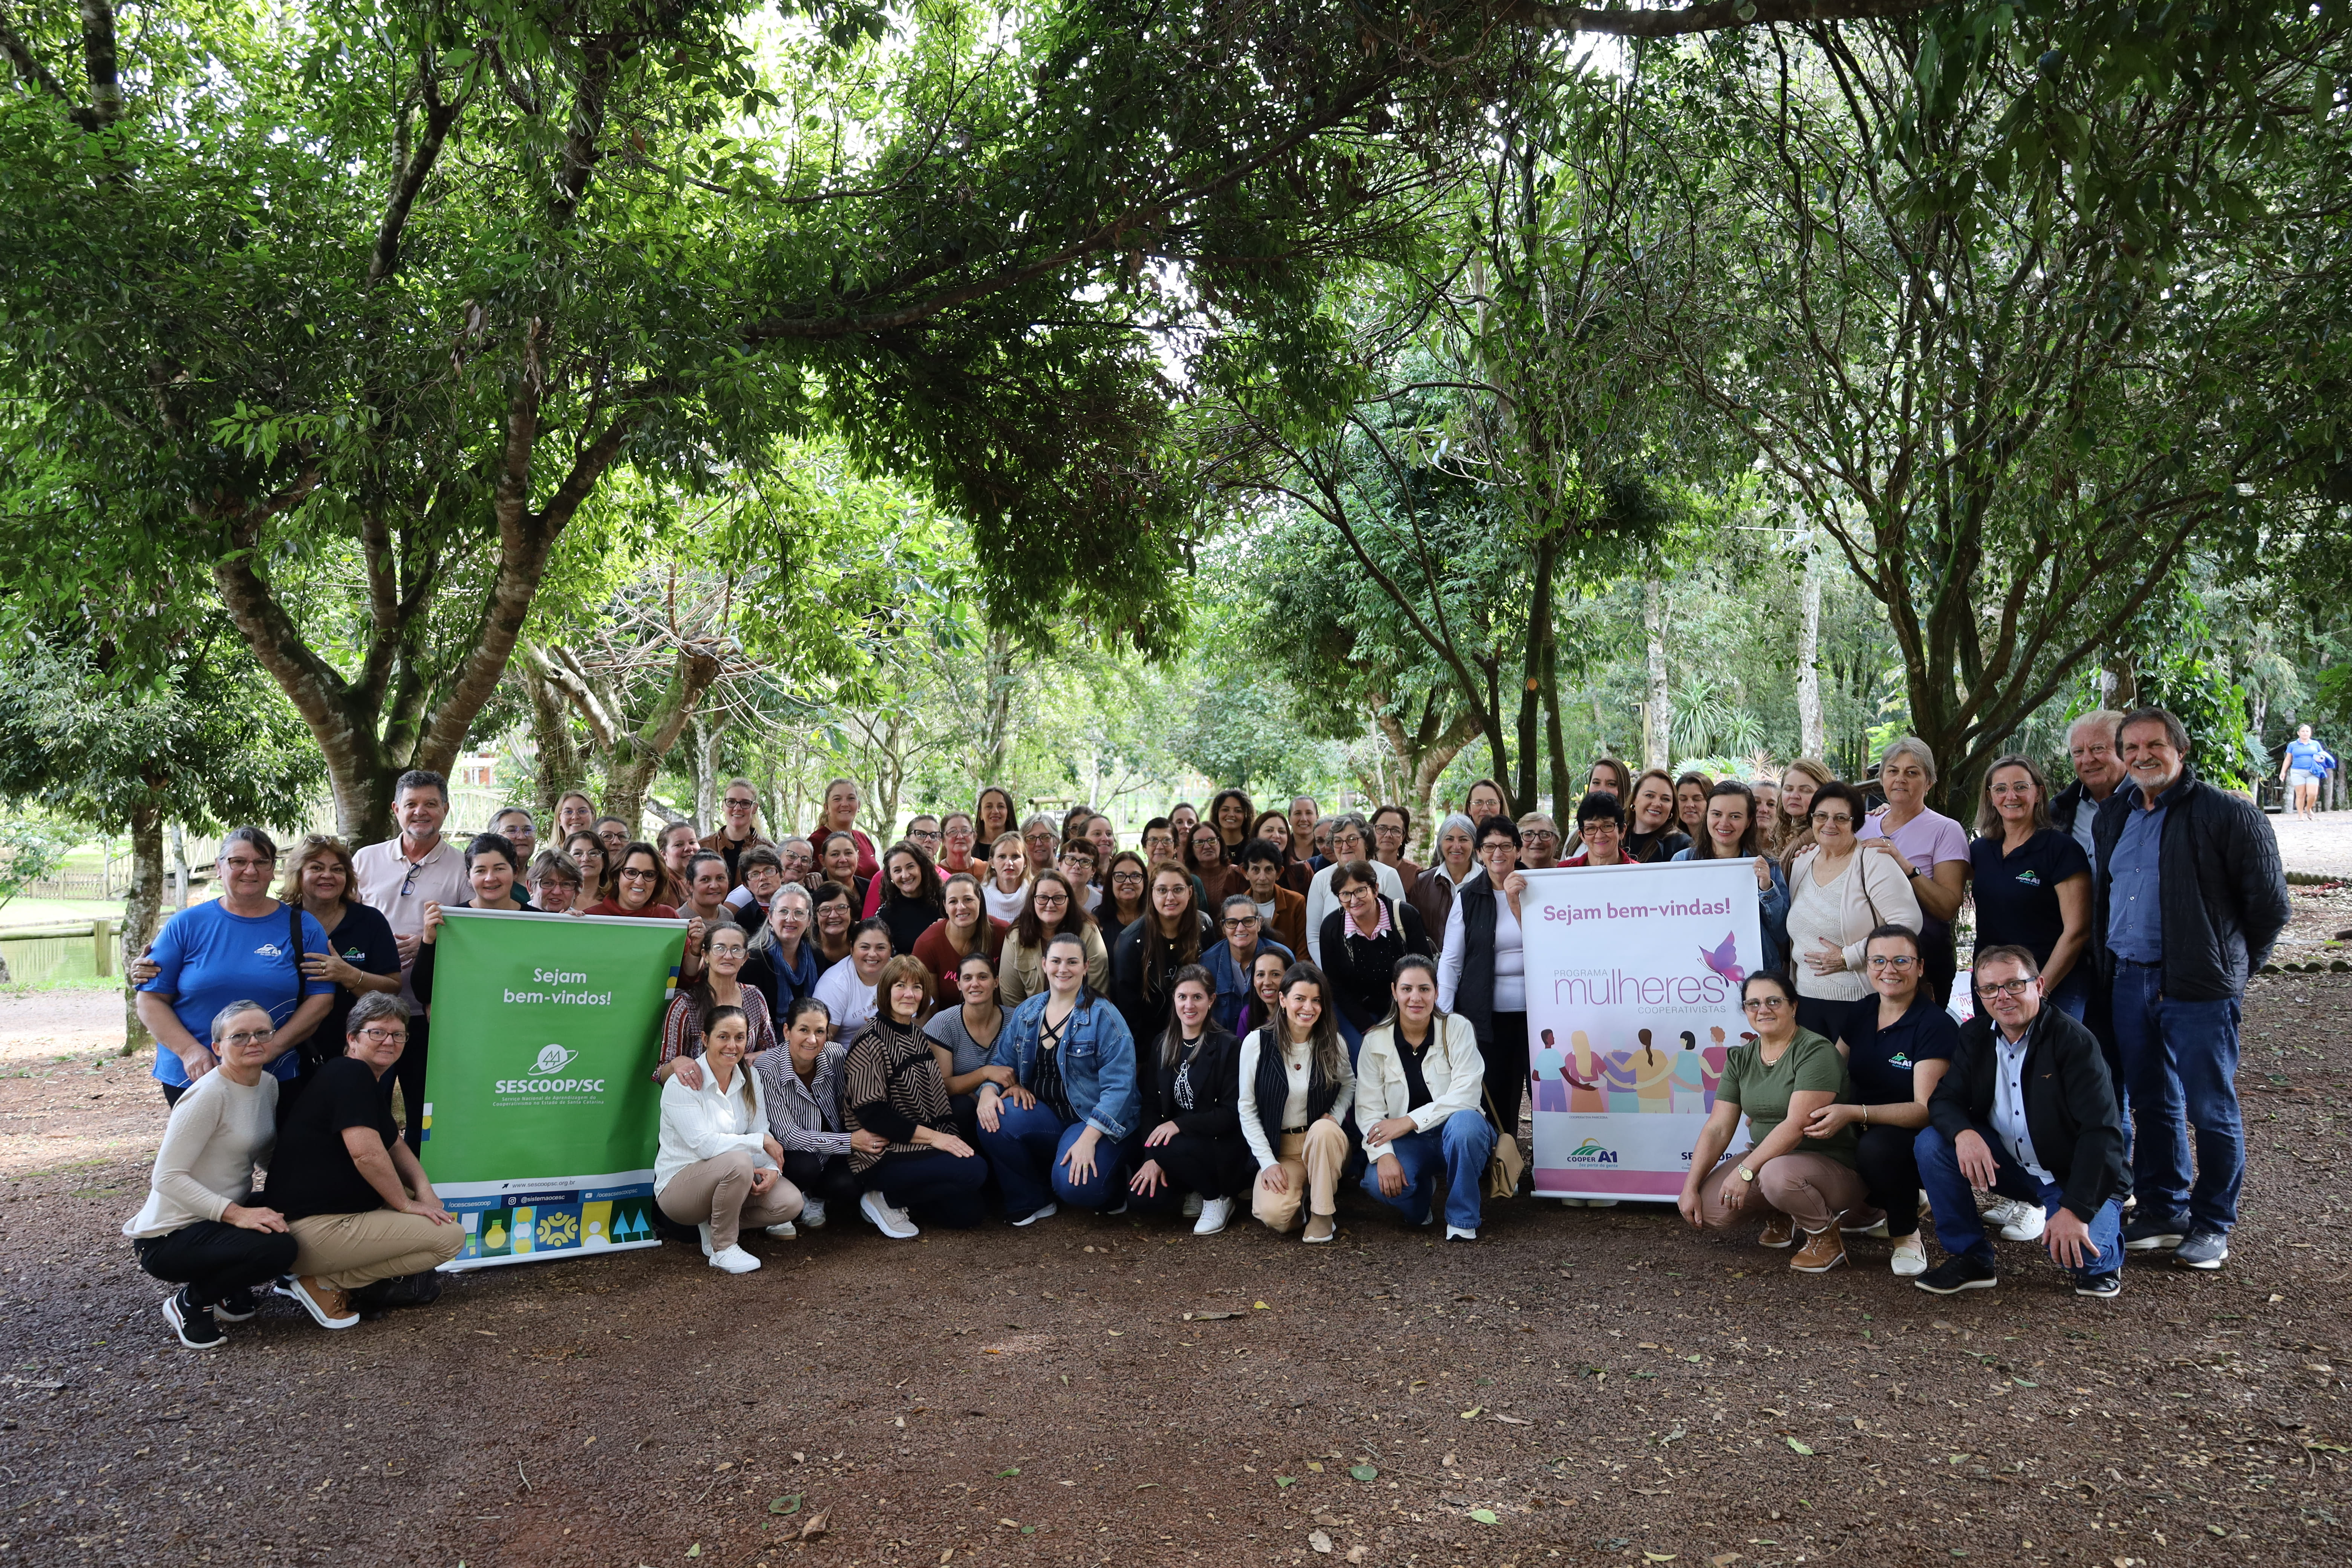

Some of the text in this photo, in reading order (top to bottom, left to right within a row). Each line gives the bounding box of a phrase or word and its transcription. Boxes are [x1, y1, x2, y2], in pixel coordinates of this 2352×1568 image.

[1544, 898, 1730, 925] Sejam bem-vindas!
[533, 968, 587, 986] Sejam
[1555, 968, 1726, 1005] mulheres
[504, 988, 611, 1005] bem-vindos!
[495, 1079, 605, 1093] SESCOOP/SC
[1598, 1151, 1617, 1162] A1
[521, 1195, 565, 1204] @sistemaocesc
[597, 1188, 638, 1197] /ocescsescoopsc
